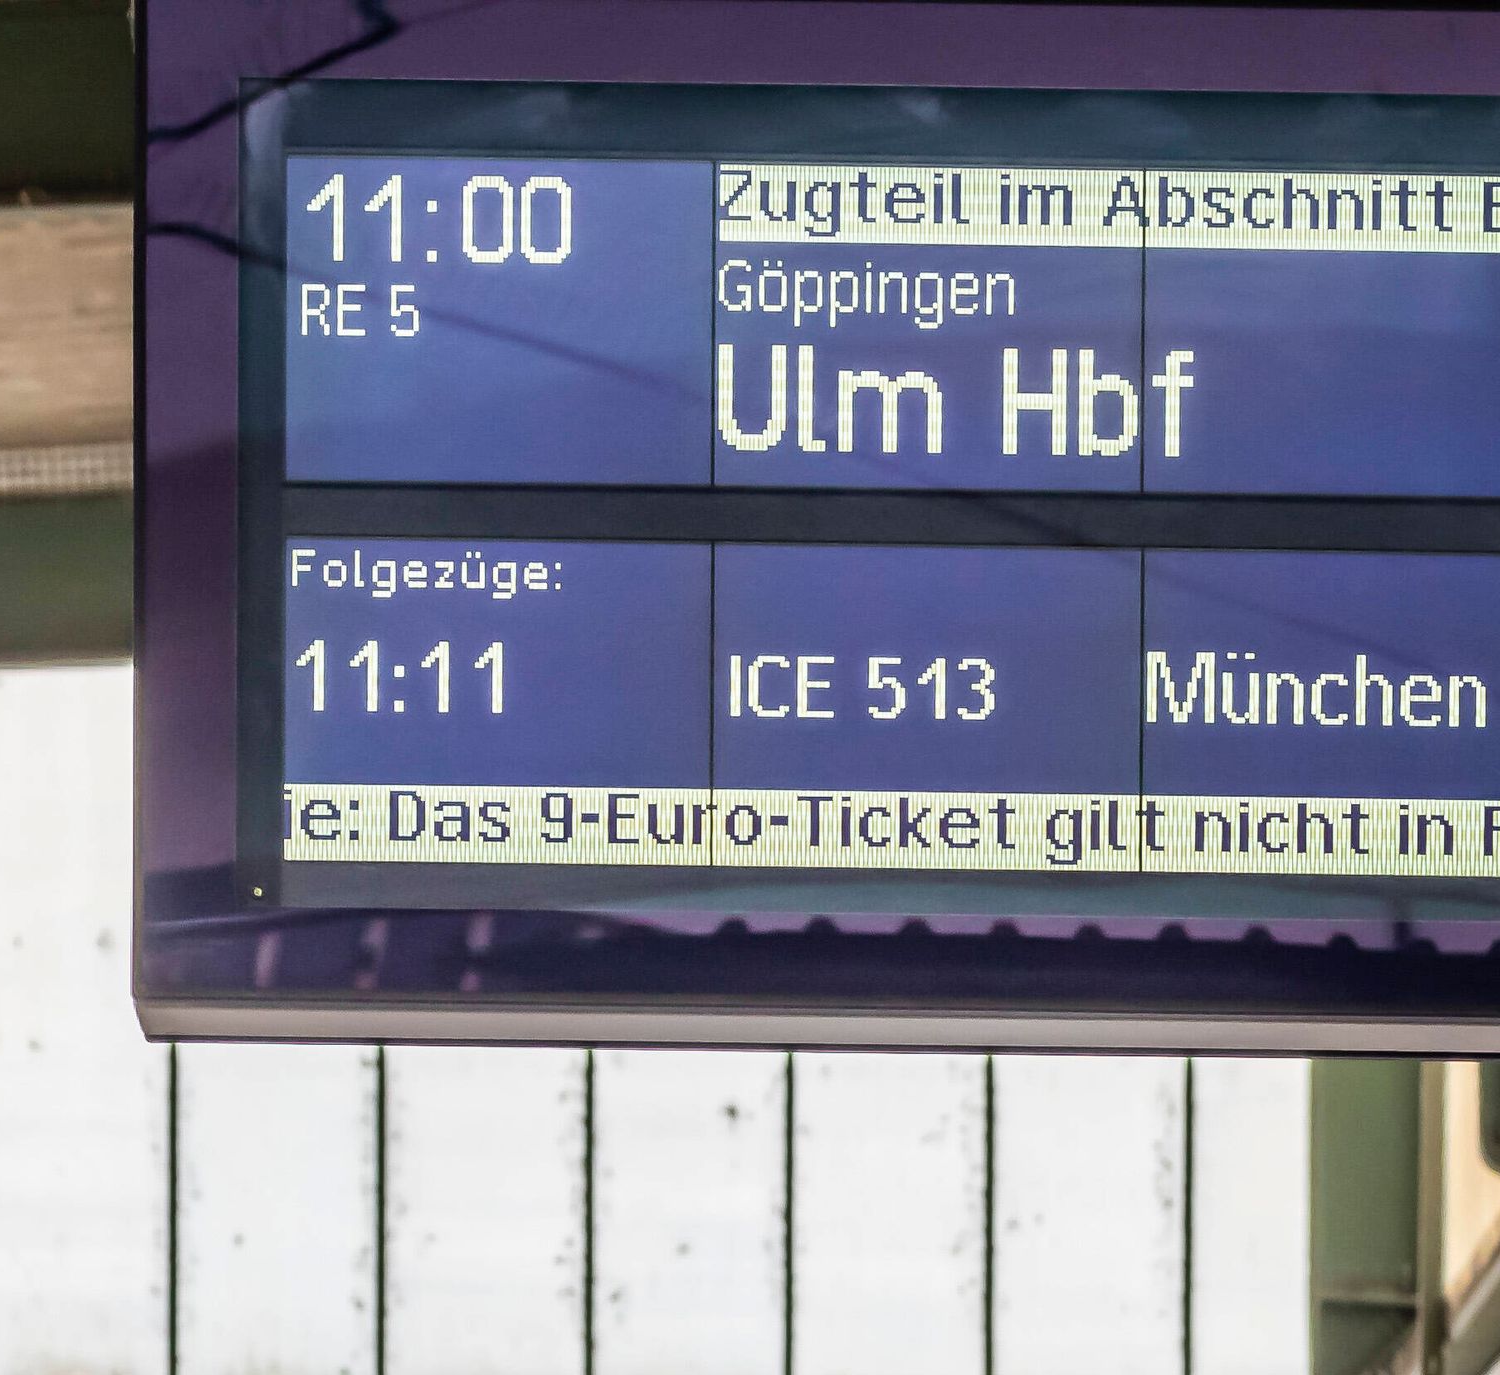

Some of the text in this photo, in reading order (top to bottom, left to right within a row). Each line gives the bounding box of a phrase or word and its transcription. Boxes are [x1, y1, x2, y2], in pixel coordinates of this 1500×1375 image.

[307, 174, 571, 263] 11:00
[719, 171, 969, 236] Zugteil
[1001, 175, 1072, 225] im
[1102, 175, 1454, 234] Abschnitt
[302, 284, 419, 336] RE 5
[719, 260, 1014, 328] Göppingen
[719, 344, 1193, 456] Ulm Hbf
[292, 550, 561, 599] Folgezüge:
[297, 640, 502, 713] 11:11
[731, 656, 834, 718] ICE
[869, 658, 994, 719] 513
[1147, 652, 1485, 727] München
[390, 791, 510, 841] Das
[541, 790, 1018, 849] 9-Euro-Ticket
[1047, 795, 1167, 867] gilt
[1194, 797, 1368, 856] nicht
[1399, 805, 1453, 855] in
